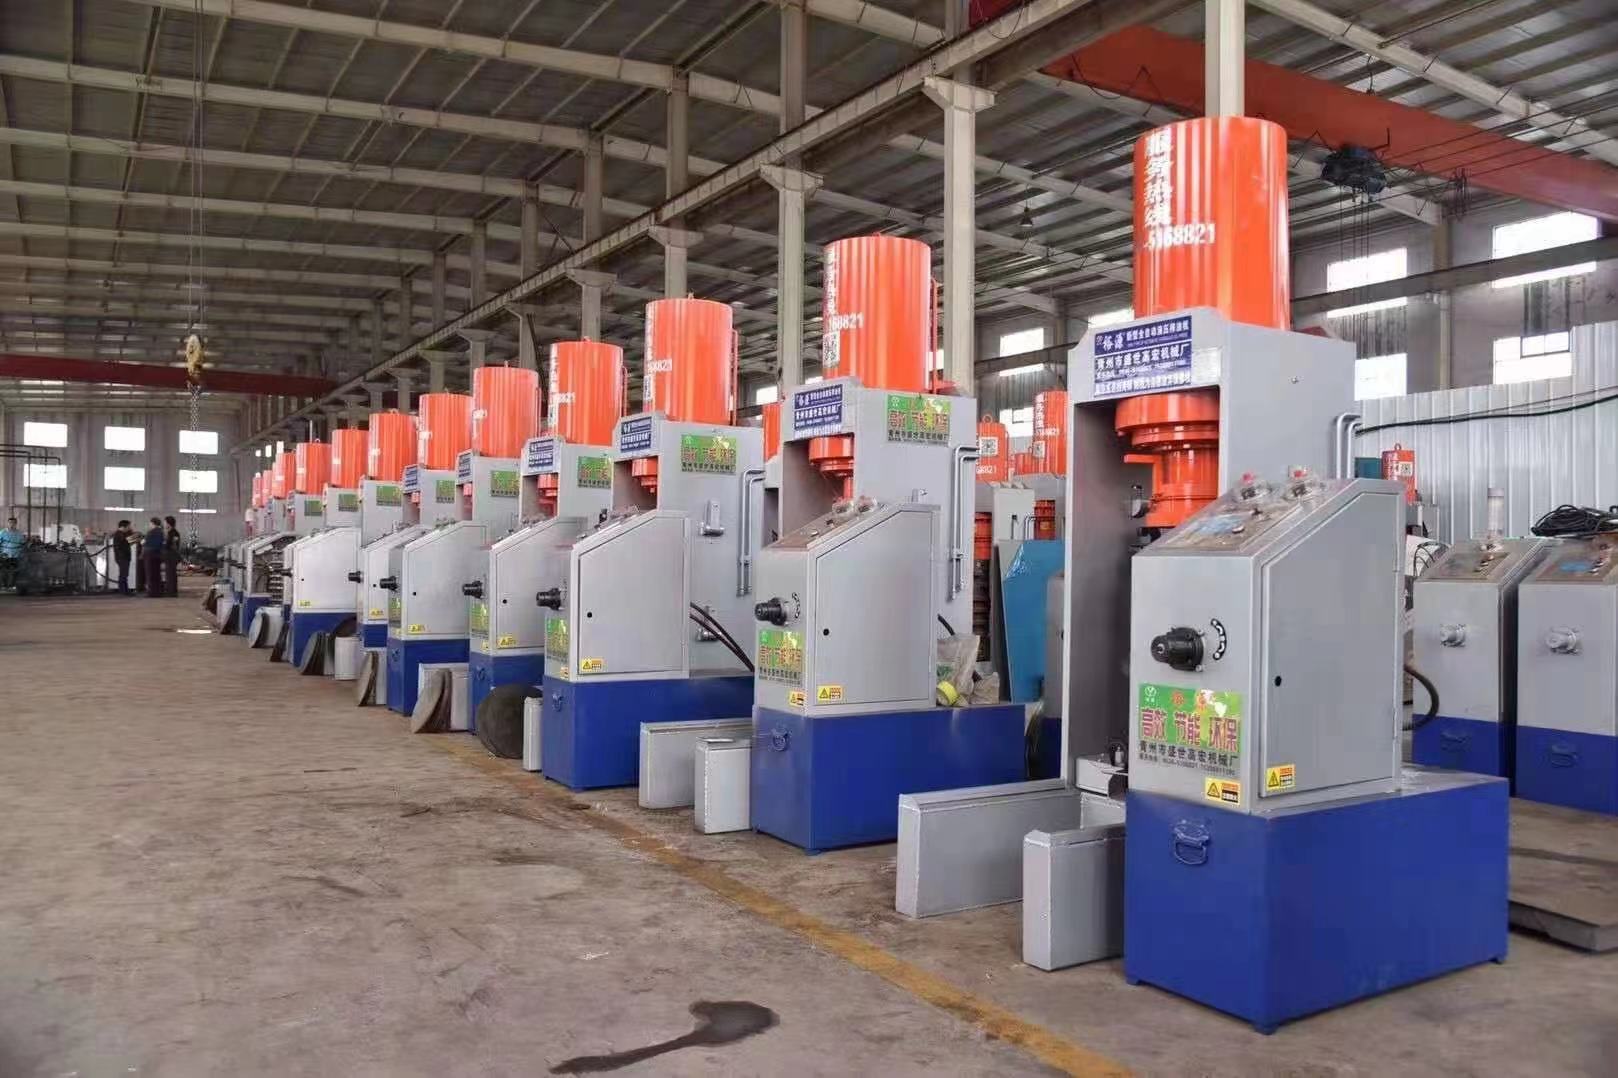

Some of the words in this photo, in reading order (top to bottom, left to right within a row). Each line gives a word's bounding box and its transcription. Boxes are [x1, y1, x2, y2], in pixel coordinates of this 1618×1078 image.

[1144, 127, 1173, 228] 服务热线
[1096, 343, 1190, 370] 青州市盛世高宏机械厂
[1141, 706, 1168, 740] 高效
[1174, 711, 1201, 746] 节能
[1208, 716, 1239, 753] 环保
[1140, 740, 1239, 767] 青州市盛世高宏机械厂
